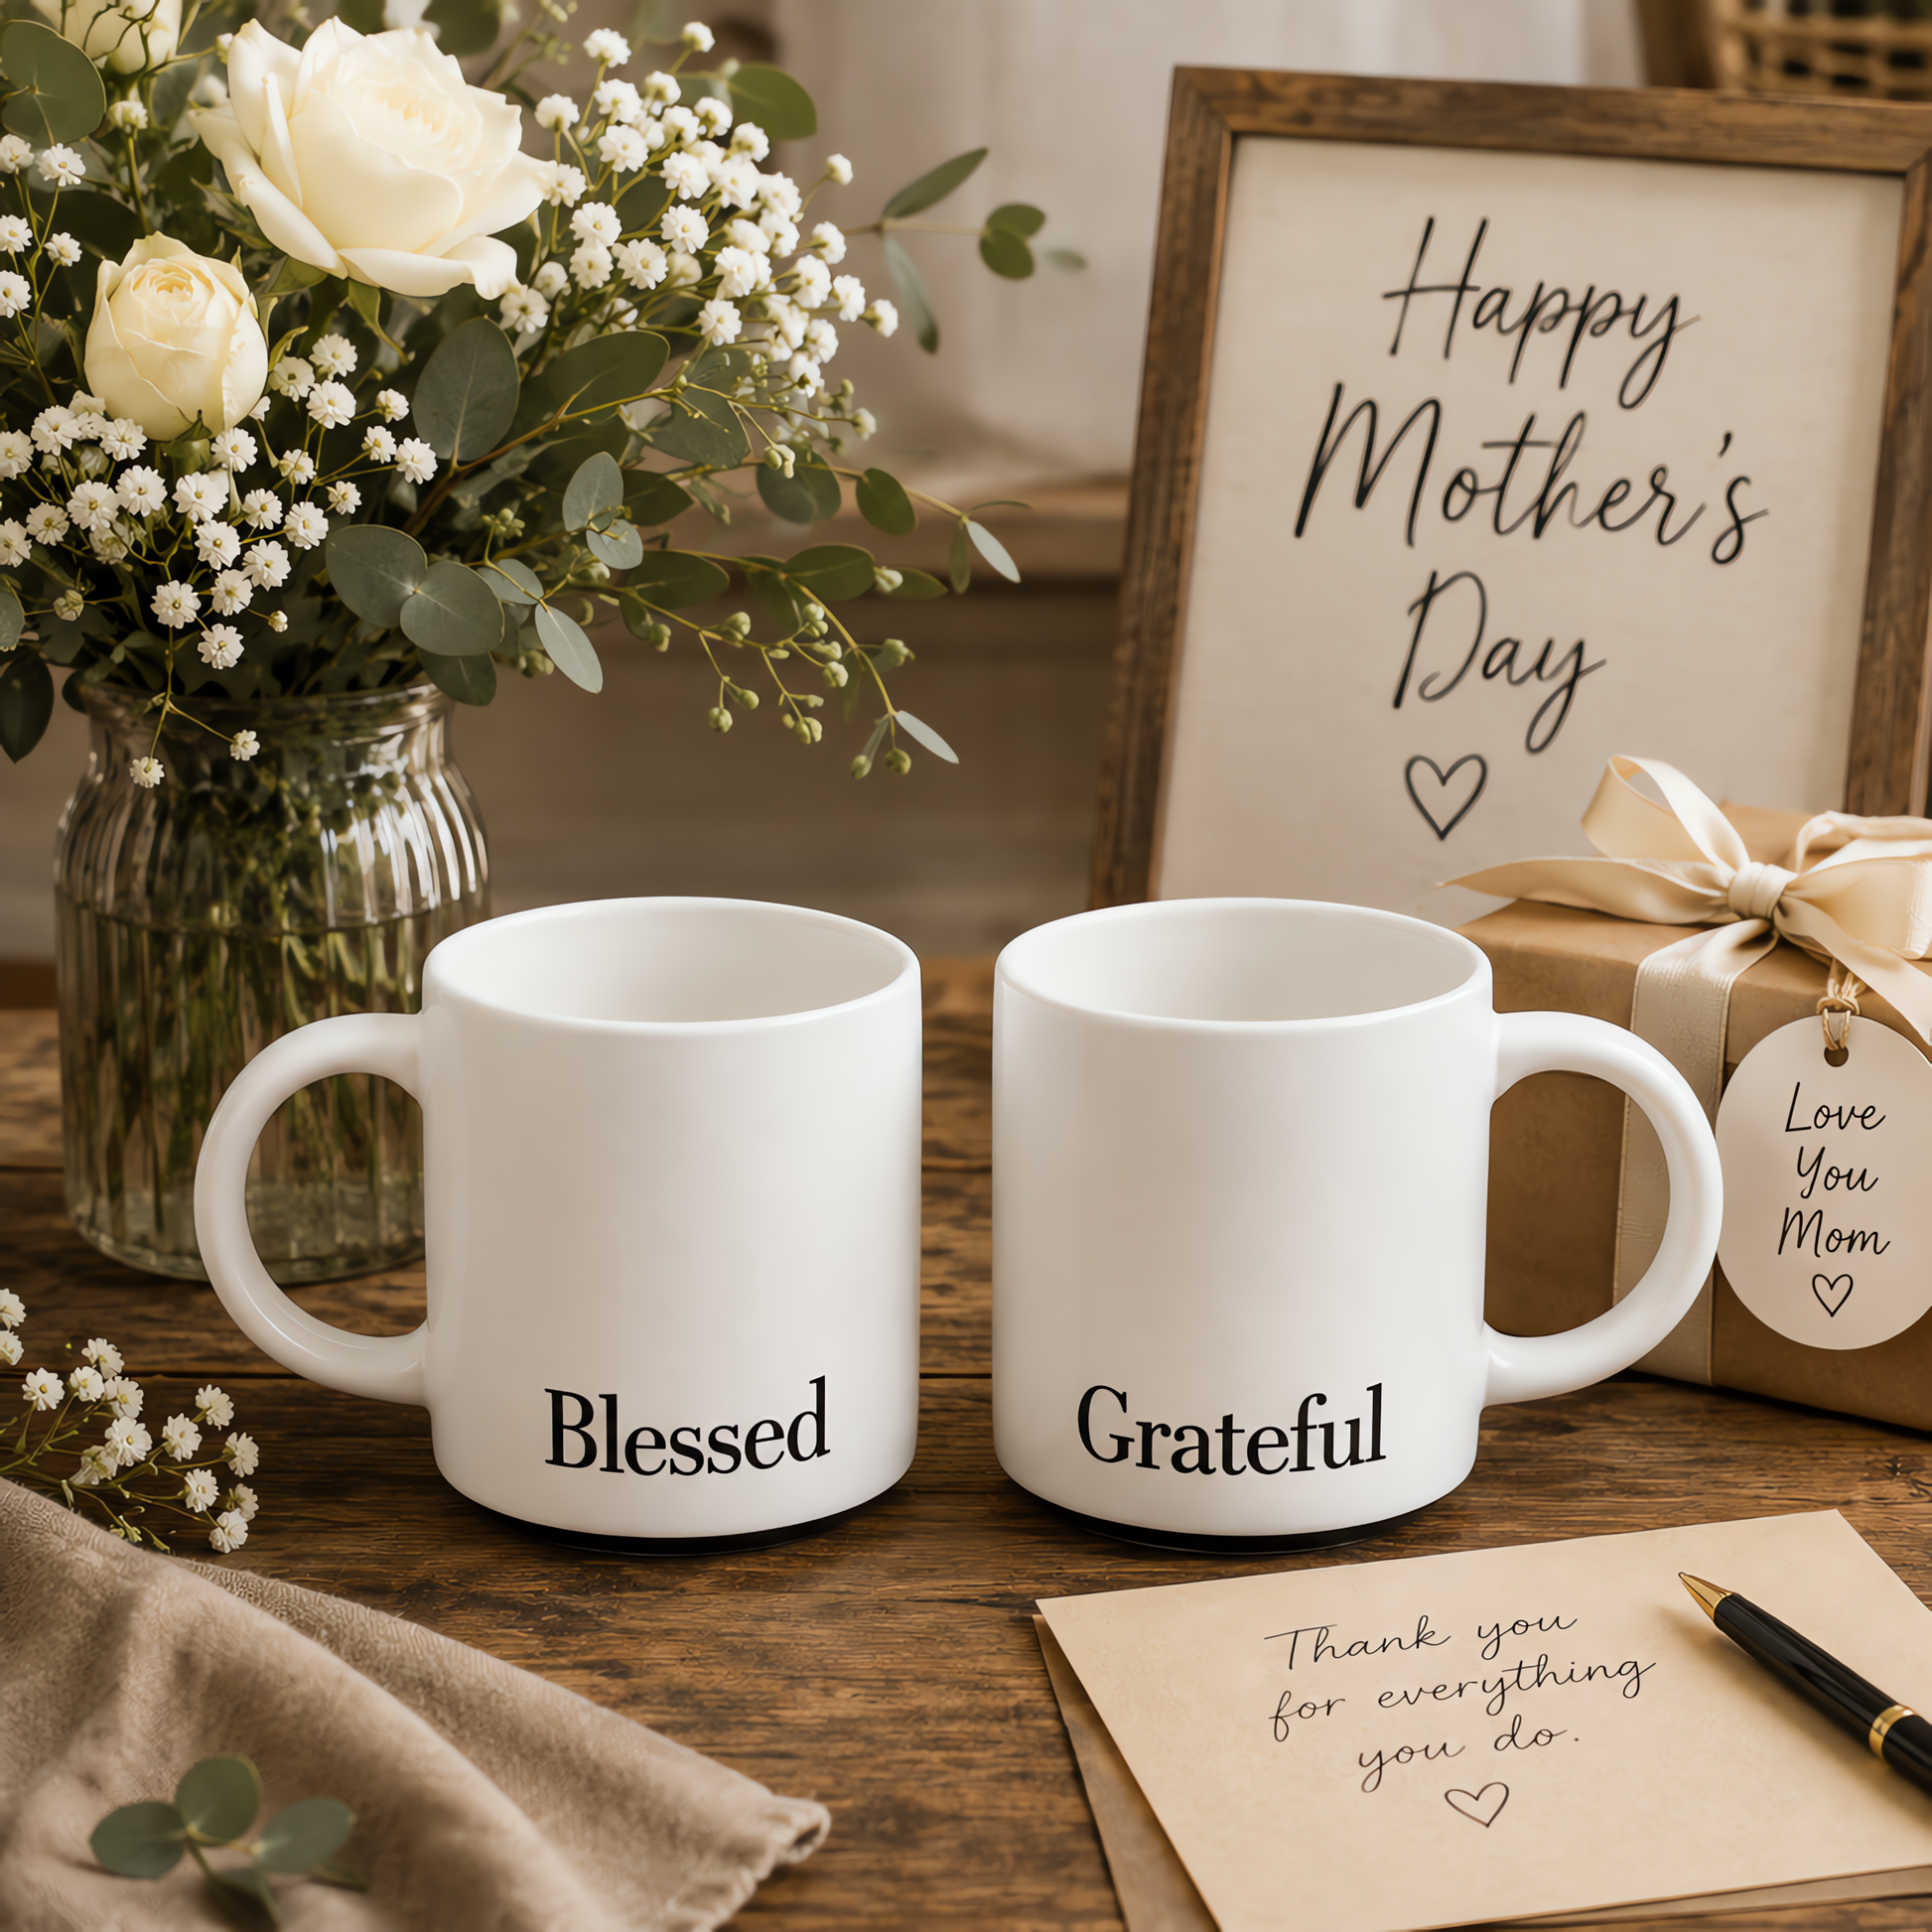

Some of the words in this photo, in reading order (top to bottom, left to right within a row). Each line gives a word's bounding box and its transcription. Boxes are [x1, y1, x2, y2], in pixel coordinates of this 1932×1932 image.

[1381, 215, 1701, 411] Happy
[1294, 380, 1769, 566] Mother's
[1392, 570, 1606, 756] Day
[1785, 1081, 1886, 1132] Love
[1797, 1146, 1878, 1199] You
[1778, 1207, 1890, 1258] Mom
[544, 1375, 831, 1476] Blessed
[1077, 1382, 1386, 1475] Grateful
[1264, 1614, 1451, 1670] Thank
[1477, 1614, 1578, 1660] you
[1269, 1691, 1345, 1742] for
[1378, 1654, 1656, 1716] everything
[1358, 1741, 1465, 1793] you
[1494, 1714, 1579, 1751] do.
